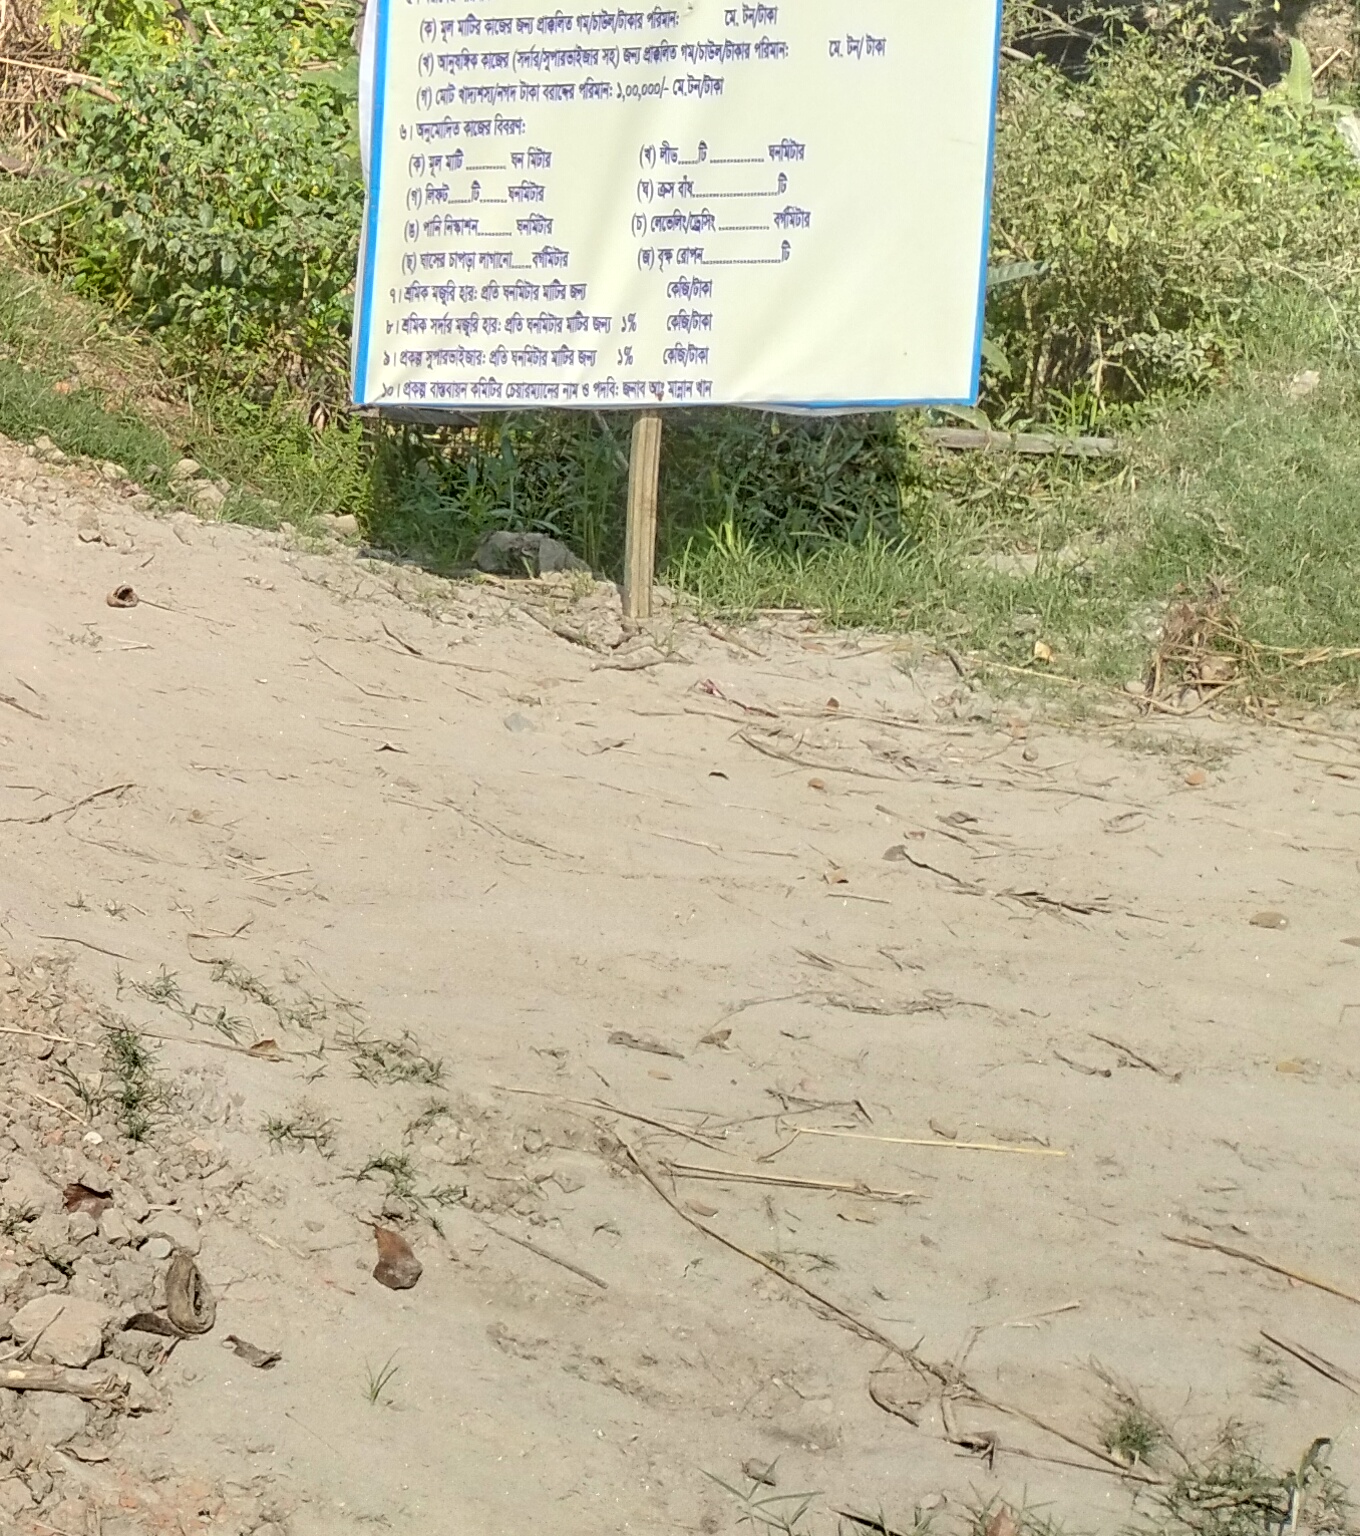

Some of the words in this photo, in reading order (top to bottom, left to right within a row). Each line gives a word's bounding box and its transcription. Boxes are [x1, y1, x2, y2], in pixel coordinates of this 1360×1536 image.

[420, 18, 436, 43] (ক)
[440, 20, 454, 43] মূল
[457, 13, 482, 36] মাটির
[484, 18, 513, 35] কাজের
[516, 17, 534, 34] জন্য
[742, 2, 778, 28] টন/টাকা
[418, 53, 434, 77] (খ)
[481, 52, 509, 69] কাজের
[602, 45, 619, 69] সহ)
[623, 47, 642, 64] জন্য
[866, 34, 886, 56] টাকা
[416, 87, 432, 111] (গ)
[436, 83, 455, 105] মোট
[519, 80, 541, 101] টাকা
[463, 120, 492, 137] কাজের
[409, 154, 425, 178] (ক)
[445, 148, 464, 171] মাটি
[511, 152, 525, 169] ঘন
[527, 146, 552, 168] মিটার
[640, 145, 656, 168] (খ)
[768, 138, 805, 161] ঘনমিটার
[407, 188, 422, 211] (গ)
[508, 180, 545, 202] ঘনমিটার
[637, 179, 653, 203] (ঘ)
[423, 215, 442, 237] পানি
[516, 213, 553, 235] ঘনমিটার
[632, 213, 647, 237] (চ)
[774, 206, 811, 229] বর্গমিটার
[402, 252, 416, 275] (ছ)
[420, 252, 445, 269] ঘাসের
[532, 245, 569, 268] বর্গমিটার
[638, 247, 654, 271] (জ)
[404, 280, 429, 303] শ্রমিক
[481, 279, 500, 302] প্রতি
[503, 279, 540, 301] ঘনমিটার
[543, 279, 566, 301] মাটির
[570, 283, 587, 300] জন্য
[667, 275, 712, 301] কেজি/টাকা
[402, 312, 427, 334] শ্রমিক
[430, 312, 454, 334] সর্দার
[505, 312, 524, 334] প্রতি
[526, 311, 564, 333] ঘনমিটার
[566, 310, 589, 333] মাটির
[593, 316, 612, 333] জন্য
[621, 313, 636, 332] ১%
[667, 309, 713, 334] কেজি/টাকা
[400, 350, 424, 367] প্রকল্প
[489, 344, 509, 367] প্রতি
[511, 344, 548, 366] ঘনমিটার
[551, 344, 574, 366] মাটির
[578, 350, 597, 367] জন্য
[618, 346, 633, 365] ১%
[663, 342, 709, 367] কেজি/টাকা
[403, 380, 426, 399] প্রকল্প
[471, 377, 503, 398] কমিটির
[563, 383, 579, 399] নাম
[582, 384, 589, 398] ও
[623, 381, 646, 398] জনাব
[696, 381, 713, 398] খান
